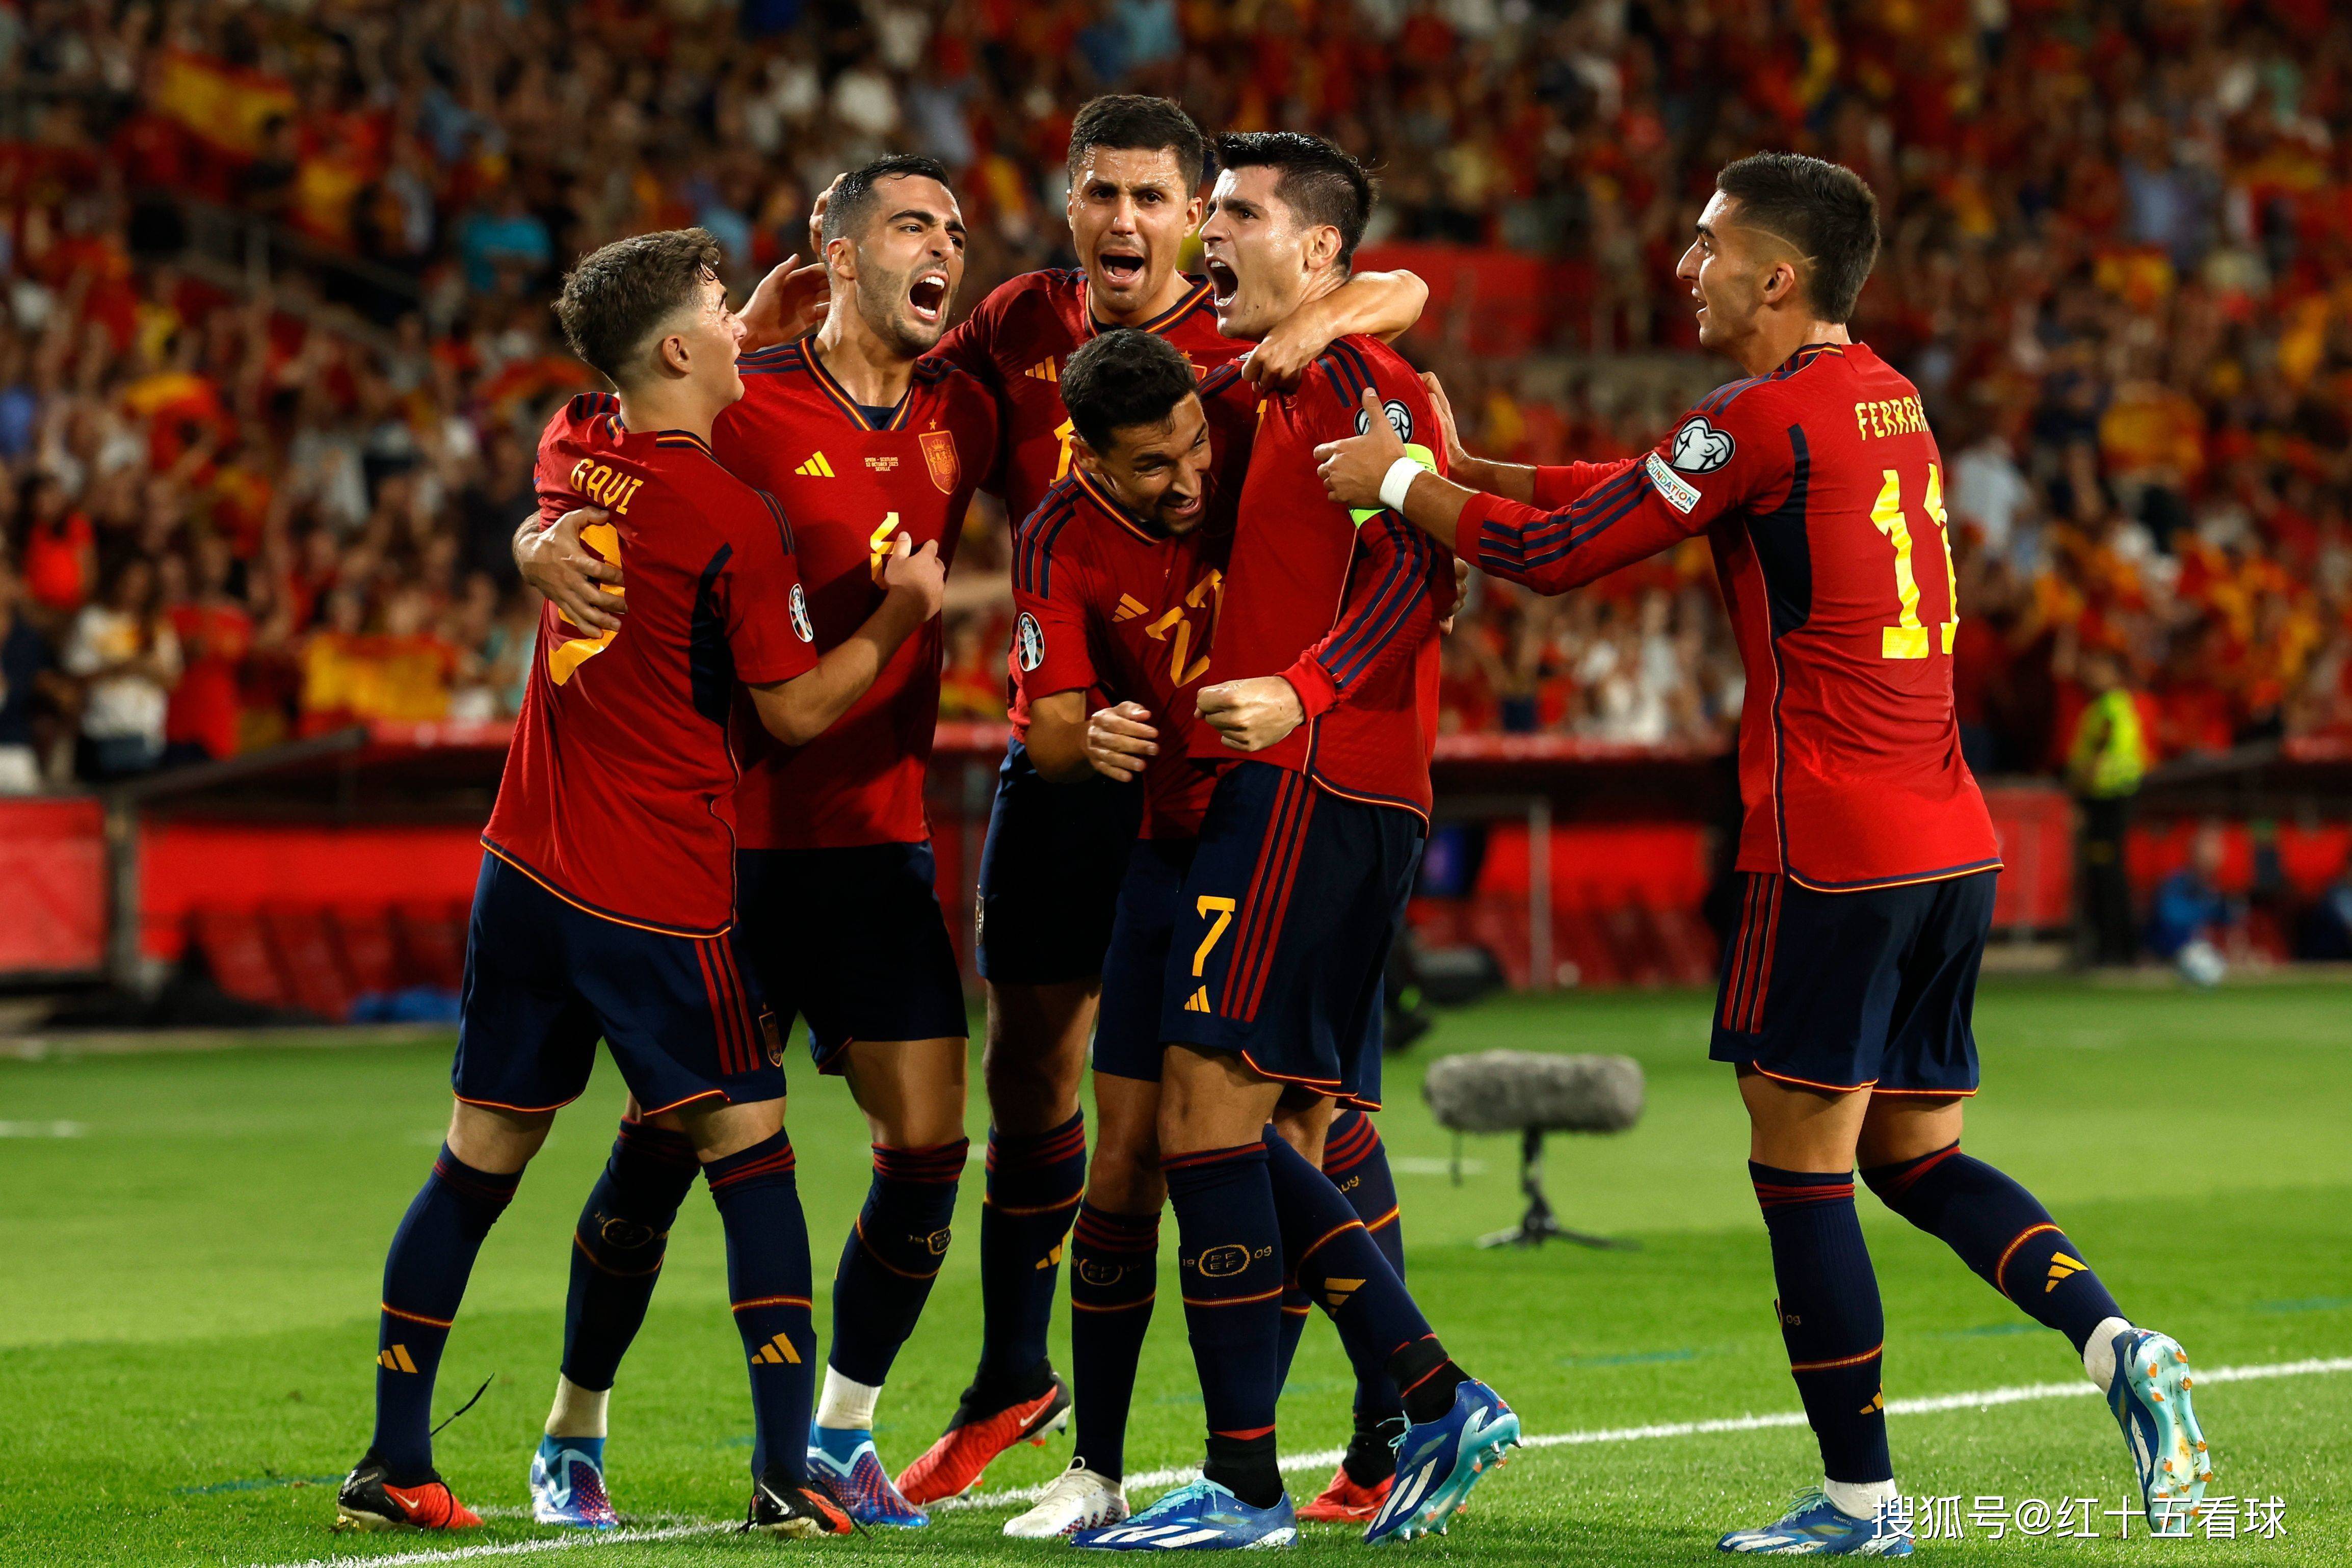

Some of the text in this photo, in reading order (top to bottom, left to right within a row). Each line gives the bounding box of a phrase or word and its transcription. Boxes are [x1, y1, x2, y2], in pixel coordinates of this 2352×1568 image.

[1855, 394, 1930, 441] FERRAN
[570, 458, 644, 515] GAVI
[1645, 459, 1696, 506] FOUNDATION
[1869, 463, 1960, 659] 11
[1145, 569, 1226, 688] 22
[1192, 895, 1236, 977] 7
[1254, 1245, 1272, 1259] 09
